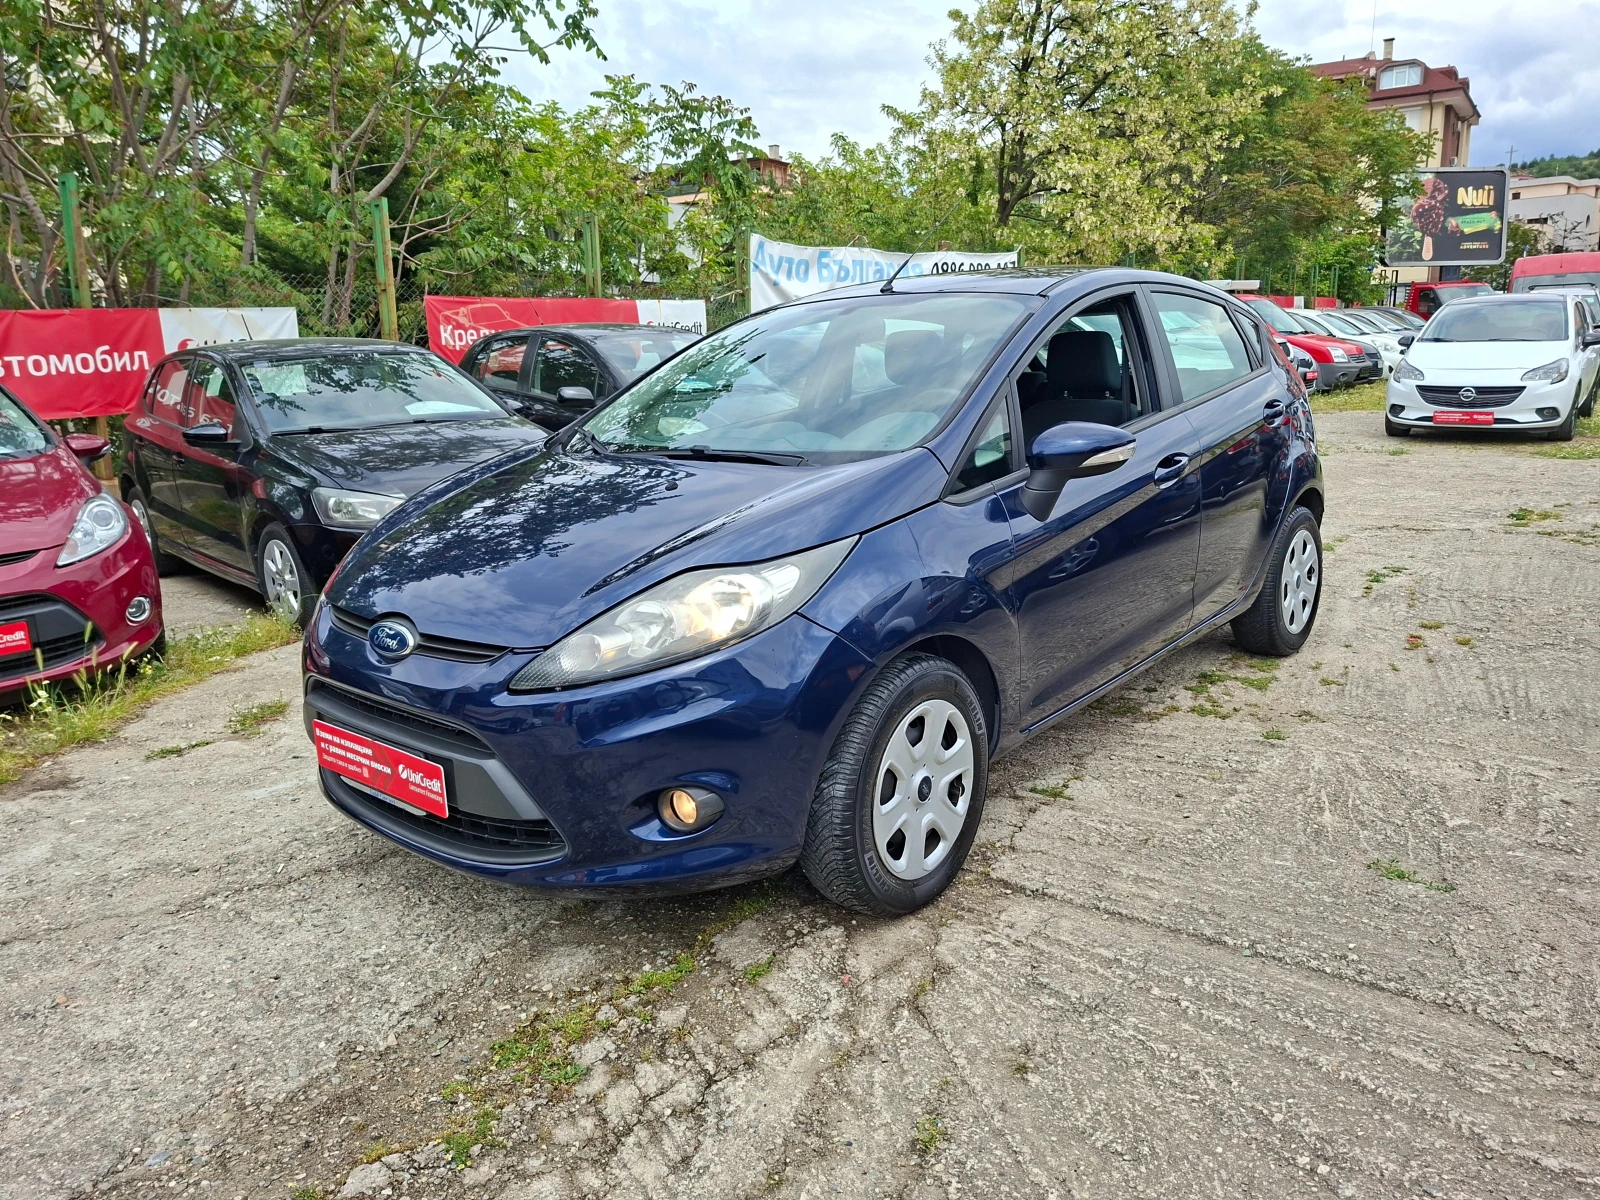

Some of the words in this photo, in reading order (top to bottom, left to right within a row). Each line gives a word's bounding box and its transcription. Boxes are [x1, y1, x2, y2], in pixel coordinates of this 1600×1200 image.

[374, 627, 401, 650] Ford
[315, 727, 333, 742] Вземи
[333, 736, 341, 744] на
[341, 738, 373, 756] изплащане
[329, 745, 346, 756] равни
[346, 751, 370, 766] месечни
[370, 760, 392, 775] вноски
[407, 767, 442, 794] UniCredit
